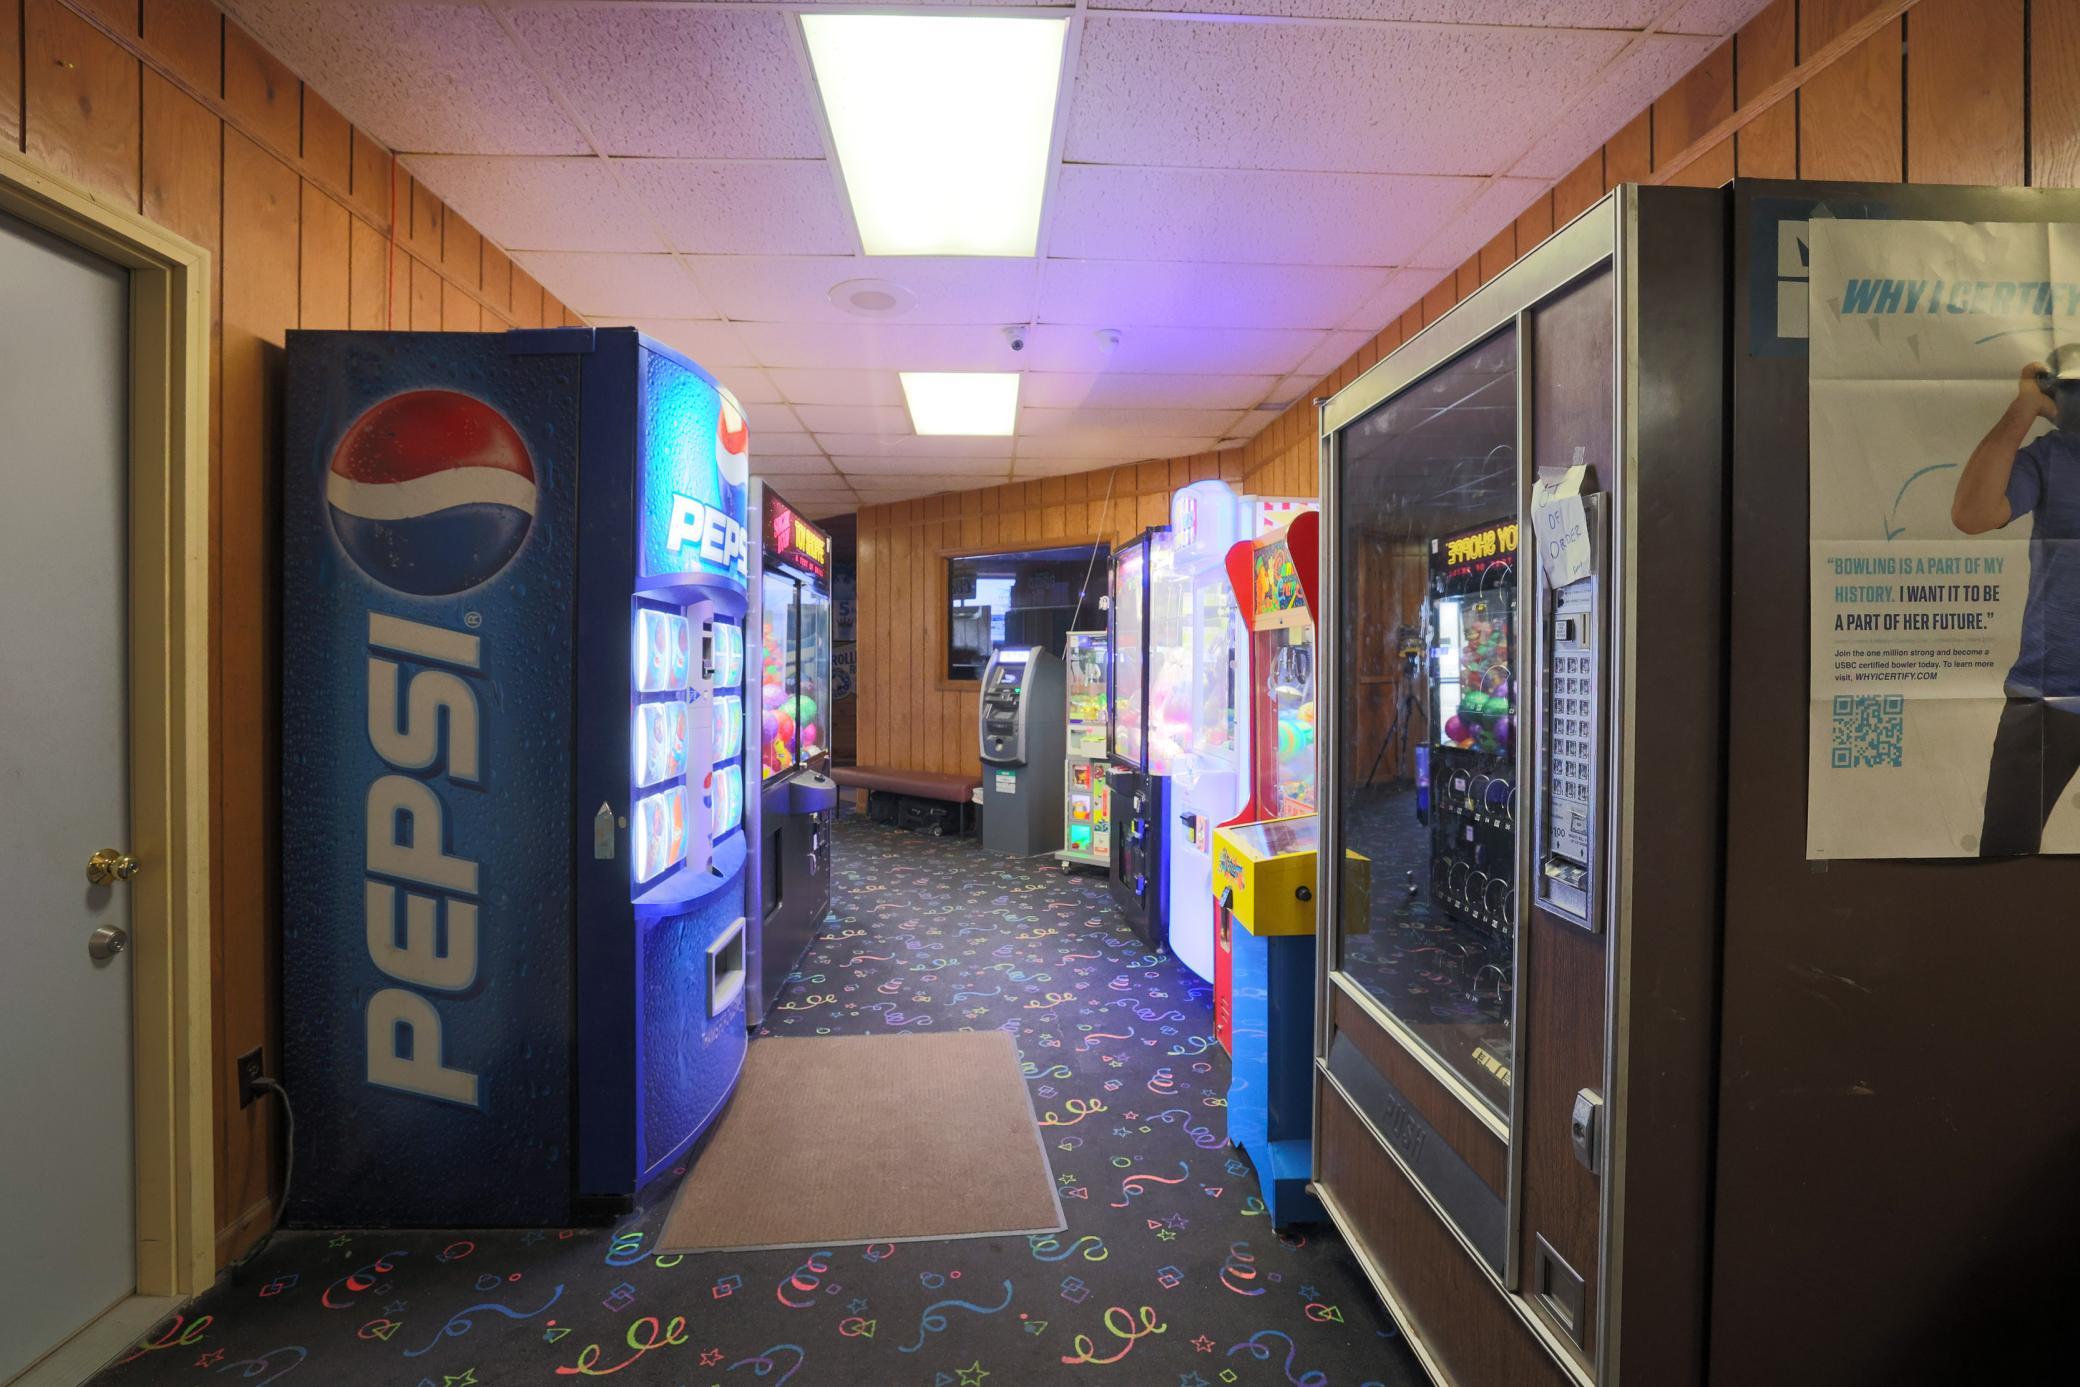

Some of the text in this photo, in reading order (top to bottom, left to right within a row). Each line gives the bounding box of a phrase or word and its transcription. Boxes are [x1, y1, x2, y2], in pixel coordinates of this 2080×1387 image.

[1841, 279, 1926, 314] WHY
[1927, 280, 1944, 314] I
[1548, 510, 1561, 531] OF
[666, 494, 747, 576] PEPS
[1549, 525, 1582, 559] ORDER
[1899, 557, 1913, 575] IS
[1915, 557, 1925, 574] A
[1928, 557, 1961, 574] PART
[1964, 557, 1981, 574] OF
[1984, 557, 2004, 574] MY
[1834, 585, 2000, 603] HISTORY. I WANT IT TO BE
[1834, 614, 1844, 631] A
[1847, 614, 1880, 631] PART
[1883, 614, 1900, 631] OF
[1903, 613, 1930, 630] HER
[1910, 649, 1935, 658] strong
[1936, 648, 1951, 656] and
[1952, 648, 1983, 656] become
[1858, 661, 1890, 669] certified
[1891, 661, 1916, 669] bowler
[1918, 661, 1941, 670] today.
[1943, 660, 1953, 668] To
[1954, 660, 1973, 668] learn
[1855, 672, 1938, 681] WHYICERTIFY.COM
[366, 611, 481, 1106] PEPSI
